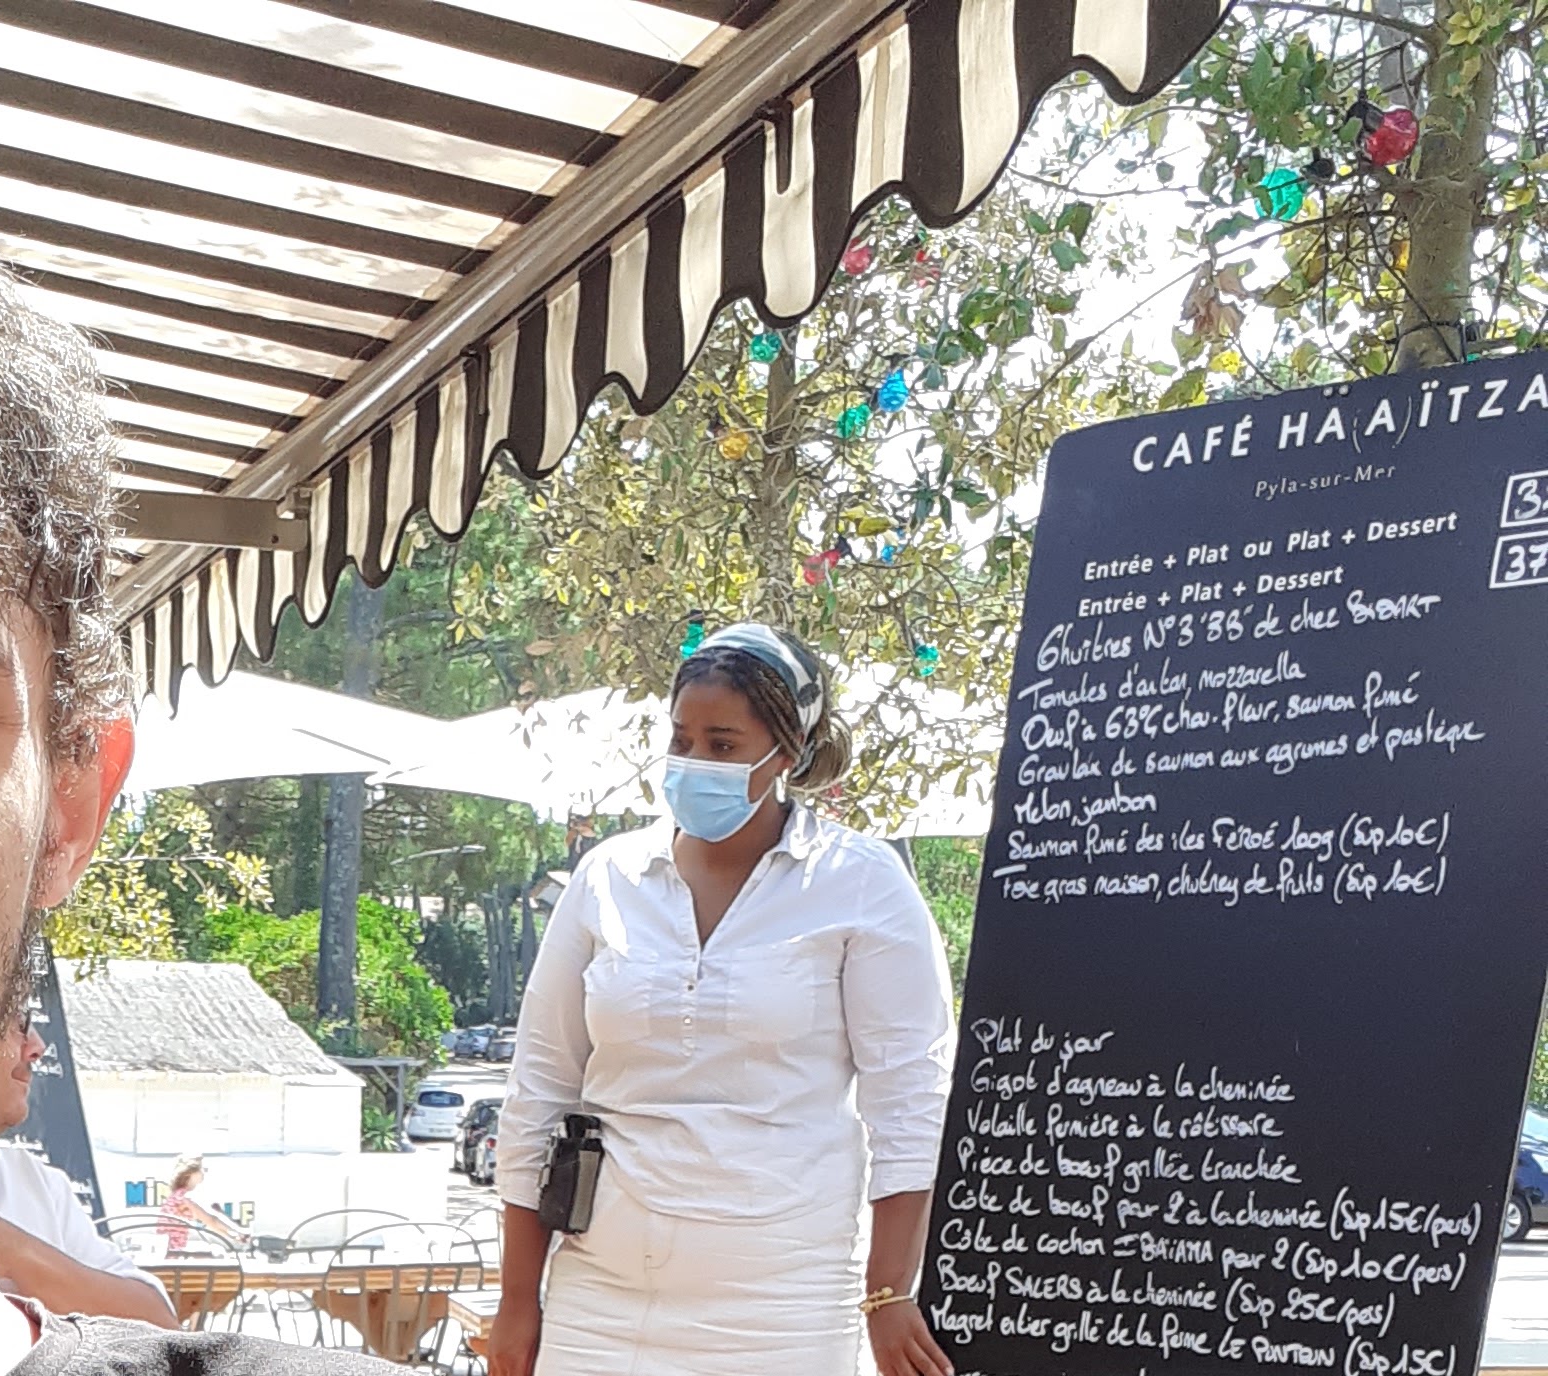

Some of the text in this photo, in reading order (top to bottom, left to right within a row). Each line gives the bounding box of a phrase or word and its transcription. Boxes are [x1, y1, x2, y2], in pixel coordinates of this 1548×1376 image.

[1132, 414, 1253, 473] CAFÉ
[1255, 464, 1396, 501] Pyla-sur-Mer
[1084, 512, 1458, 581] Entrée + Plat ou Plat + Dessert
[1078, 566, 1345, 617] Entrée + Plat + Dessert
[1254, 602, 1284, 639] de
[1290, 597, 1340, 633] chez
[1017, 672, 1108, 711] Tomates
[1199, 650, 1307, 691] mozzarella
[1081, 717, 1097, 742] à
[1285, 694, 1356, 719] saumon
[1362, 670, 1422, 718] fumé
[1110, 747, 1138, 778] de
[1145, 750, 1215, 775] saumon
[1220, 749, 1260, 768] aux
[1265, 734, 1348, 775] agrumes
[1356, 716, 1378, 754] et
[1008, 829, 1078, 860] Saumon
[1083, 823, 1130, 864] fumé
[1135, 822, 1164, 853] des
[1043, 876, 1088, 905] gras
[1243, 863, 1274, 894] de
[970, 1015, 1023, 1054] Plat
[1030, 1023, 1055, 1054] du
[970, 1057, 1296, 1106] Gigot d'agneau à la cheminée
[967, 1099, 1038, 1138] Volaille
[1125, 1113, 1146, 1138] à
[1153, 1103, 1174, 1139] la
[1019, 1142, 1051, 1176] de
[1201, 1147, 1303, 1184] tranchée
[1009, 1184, 1041, 1216] de
[1163, 1190, 1185, 1225] 2
[1185, 1199, 1208, 1226] à
[1210, 1189, 1235, 1226] la
[1002, 1223, 1029, 1253] de
[1036, 1226, 1106, 1256] cochon
[1271, 1236, 1290, 1270] 2
[1086, 1280, 1110, 1303] à
[1111, 1267, 1131, 1304] la
[930, 1295, 994, 1345] Magret
[1106, 1312, 1135, 1347] de
[1136, 1312, 1157, 1347] la
